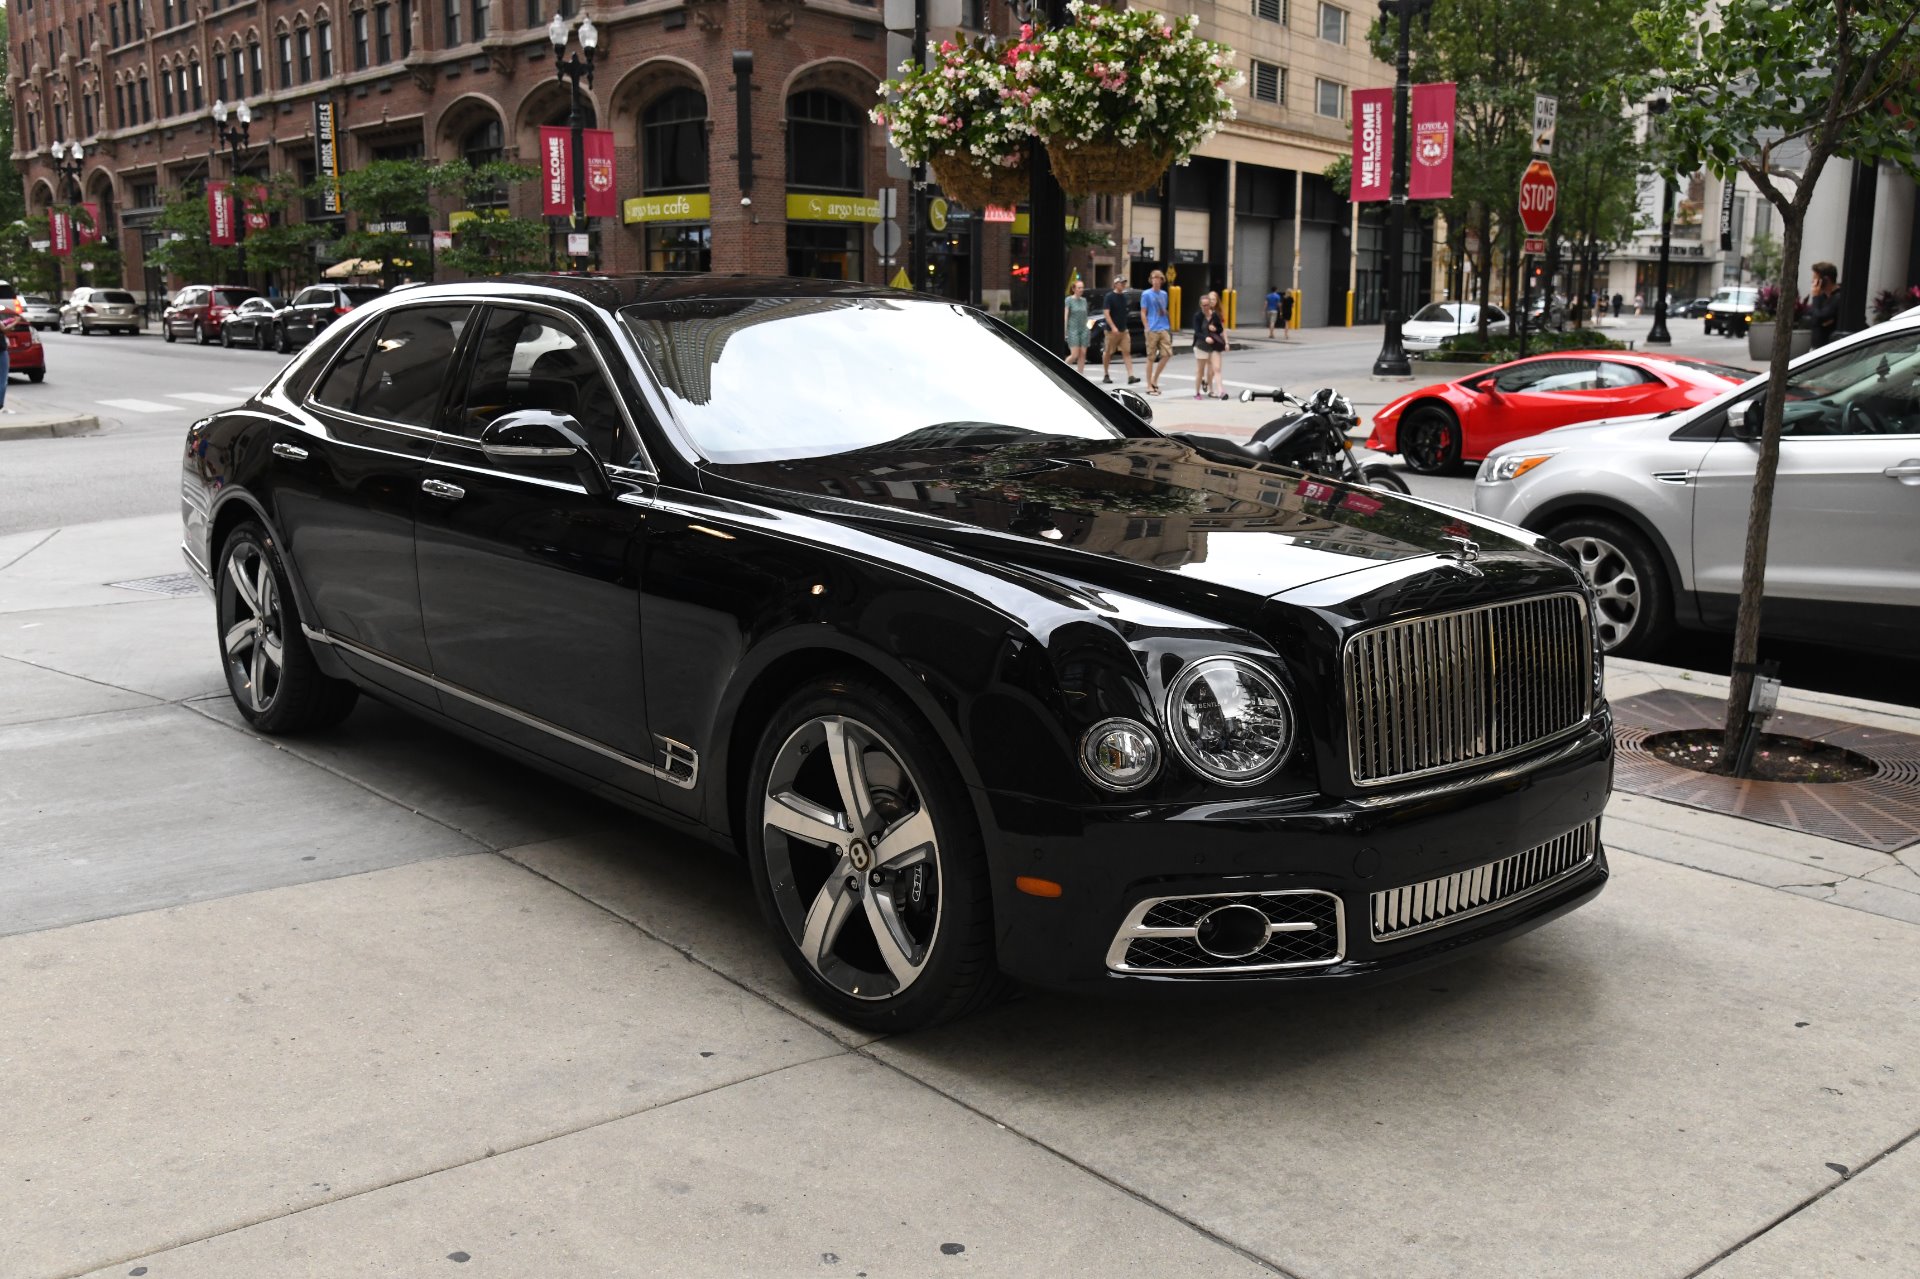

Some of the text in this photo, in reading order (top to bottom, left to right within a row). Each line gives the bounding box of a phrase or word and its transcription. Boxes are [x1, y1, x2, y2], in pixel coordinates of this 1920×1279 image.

[1538, 101, 1554, 116] ONE
[319, 104, 331, 140] BAGELS
[1417, 121, 1448, 131] LOYOLA
[1536, 117, 1553, 130] WAY
[1361, 103, 1375, 188] WELCOME
[549, 137, 560, 205] WELCOME
[663, 196, 690, 215] café
[1521, 183, 1555, 211] STOP
[828, 203, 852, 220] argo
[853, 203, 866, 217] tea
